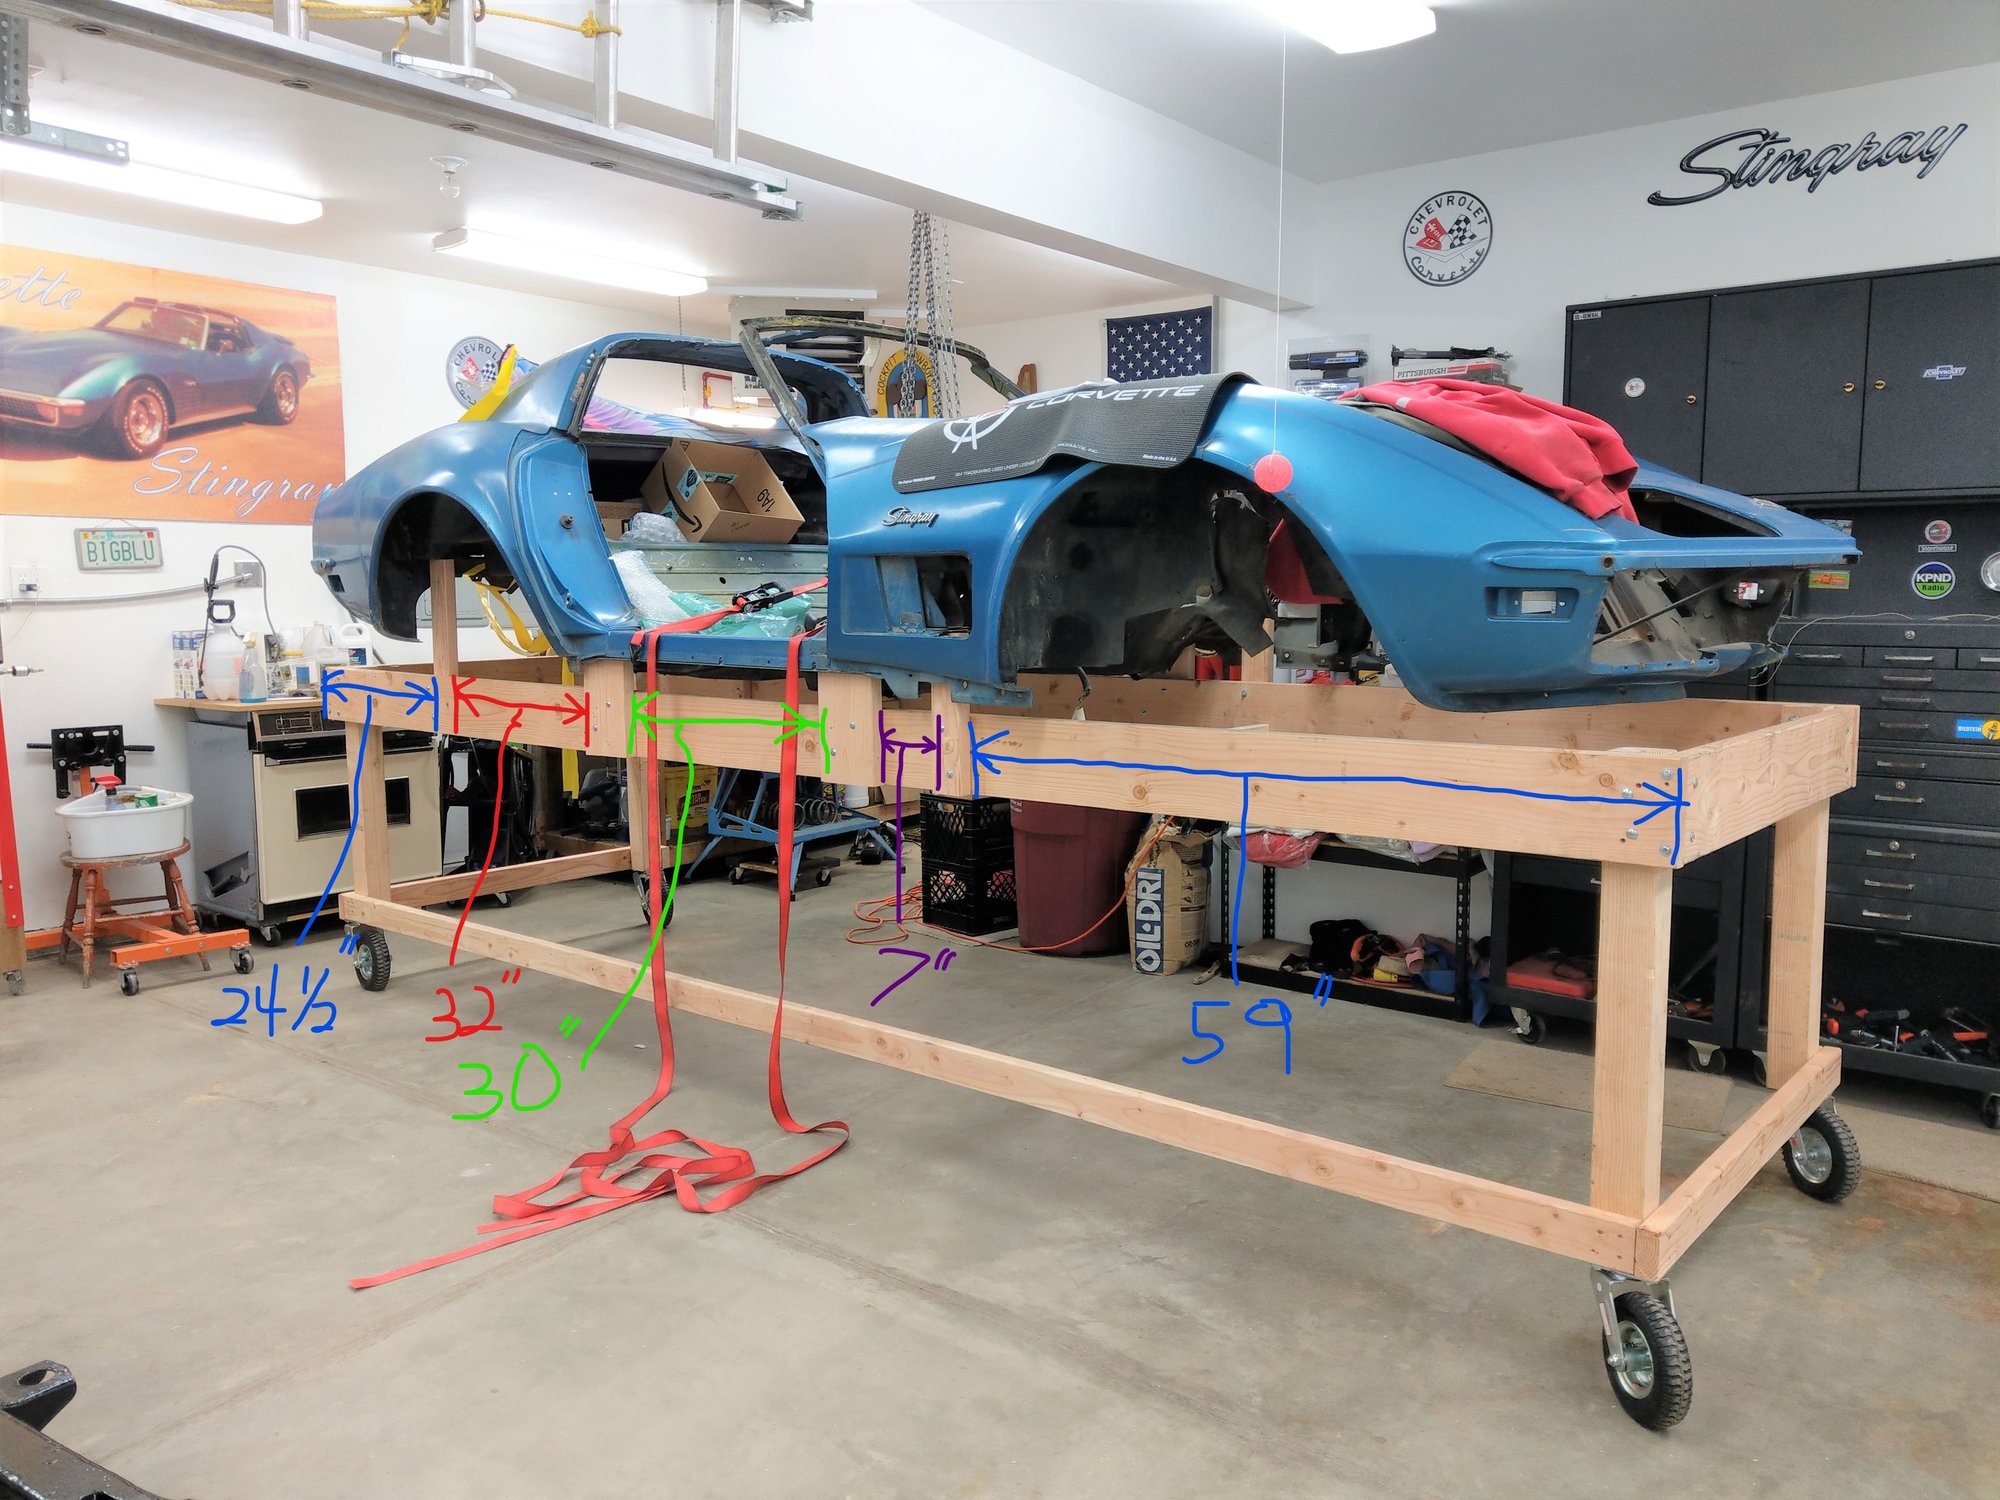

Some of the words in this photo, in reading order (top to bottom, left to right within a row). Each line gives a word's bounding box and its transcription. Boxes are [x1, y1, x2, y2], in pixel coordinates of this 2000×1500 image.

[1648, 123, 1968, 206] Stingray
[1409, 195, 1488, 235] CHEVROLET
[1410, 247, 1485, 282] Corvette
[877, 353, 897, 395] COCKPIT
[1397, 367, 1447, 379] PITTSBURGH
[1026, 385, 1204, 410] CORVETTE
[881, 506, 938, 528] Stingray
[87, 540, 155, 562] BIGBLU
[1916, 573, 1952, 583] KPND
